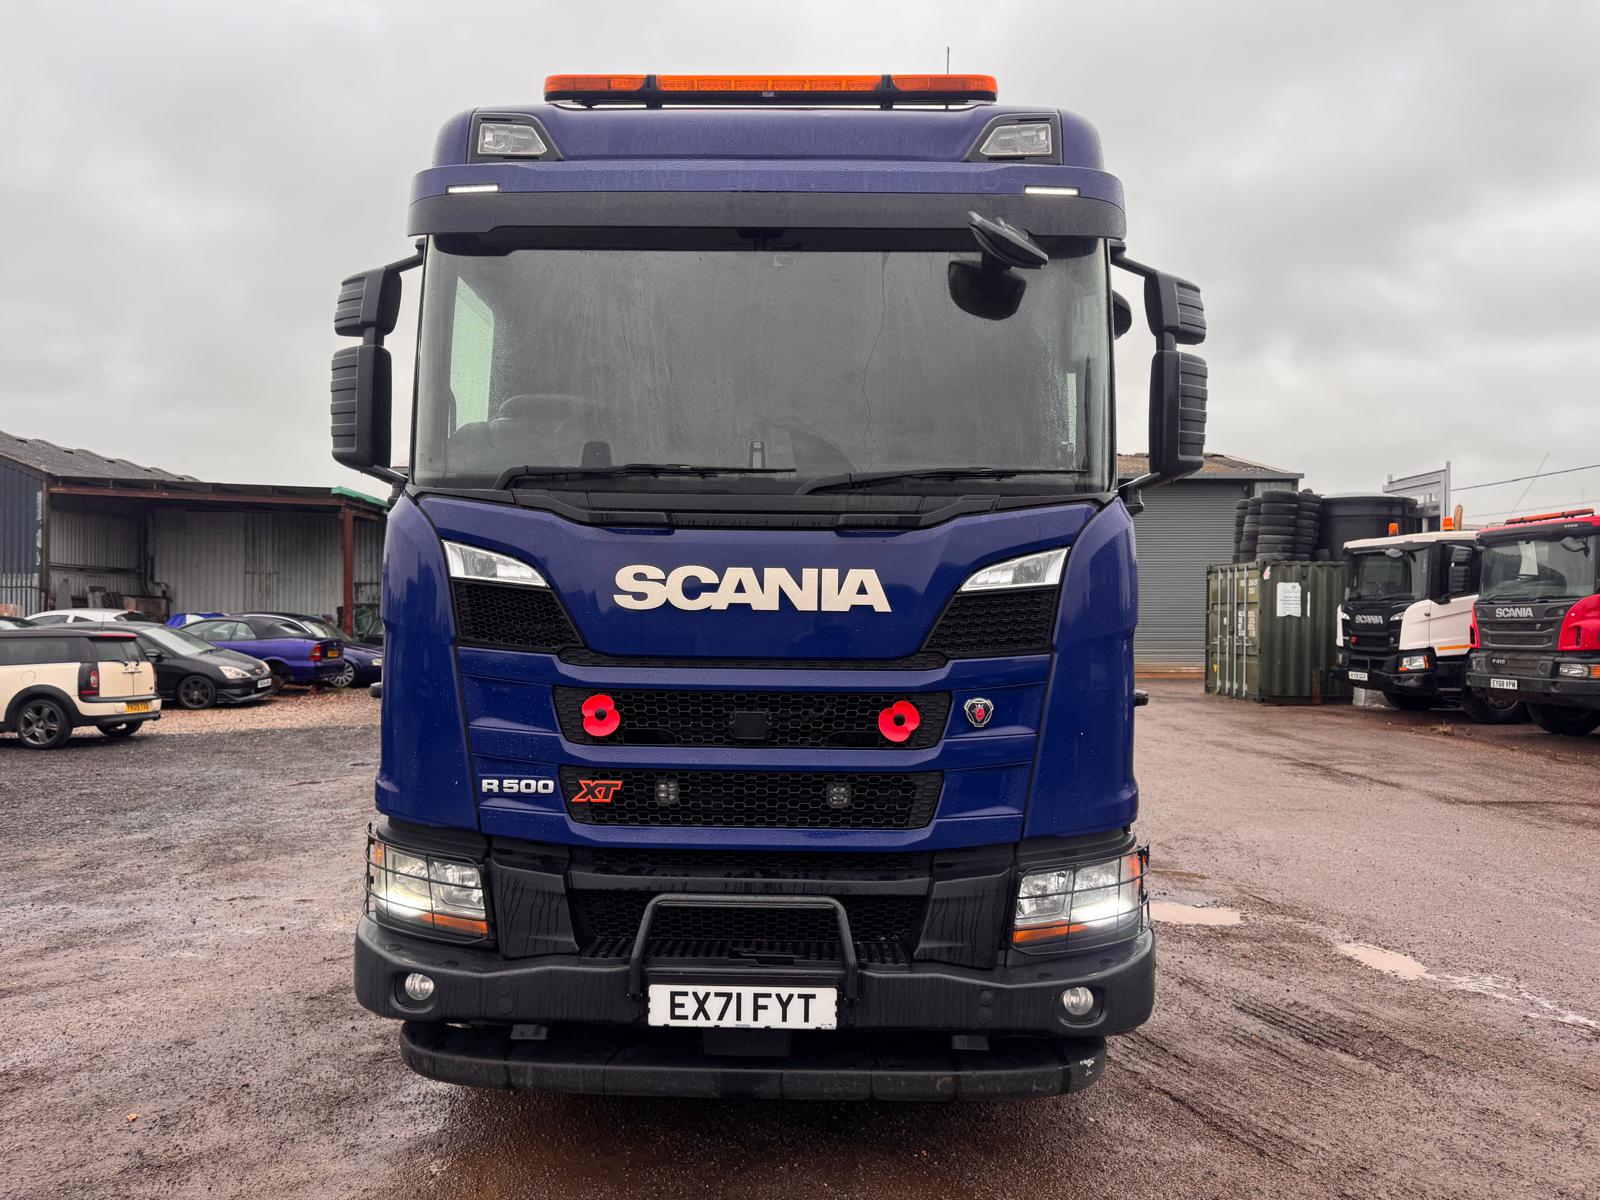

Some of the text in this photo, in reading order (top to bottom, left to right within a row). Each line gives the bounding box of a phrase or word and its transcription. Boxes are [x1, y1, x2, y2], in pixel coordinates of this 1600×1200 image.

[613, 565, 892, 612] SCANIA
[1355, 614, 1384, 625] SCANIA
[1495, 607, 1534, 618] SCANIA
[481, 779, 555, 794] R 500
[571, 779, 624, 803] XT
[669, 990, 817, 1023] EX71 FYT
